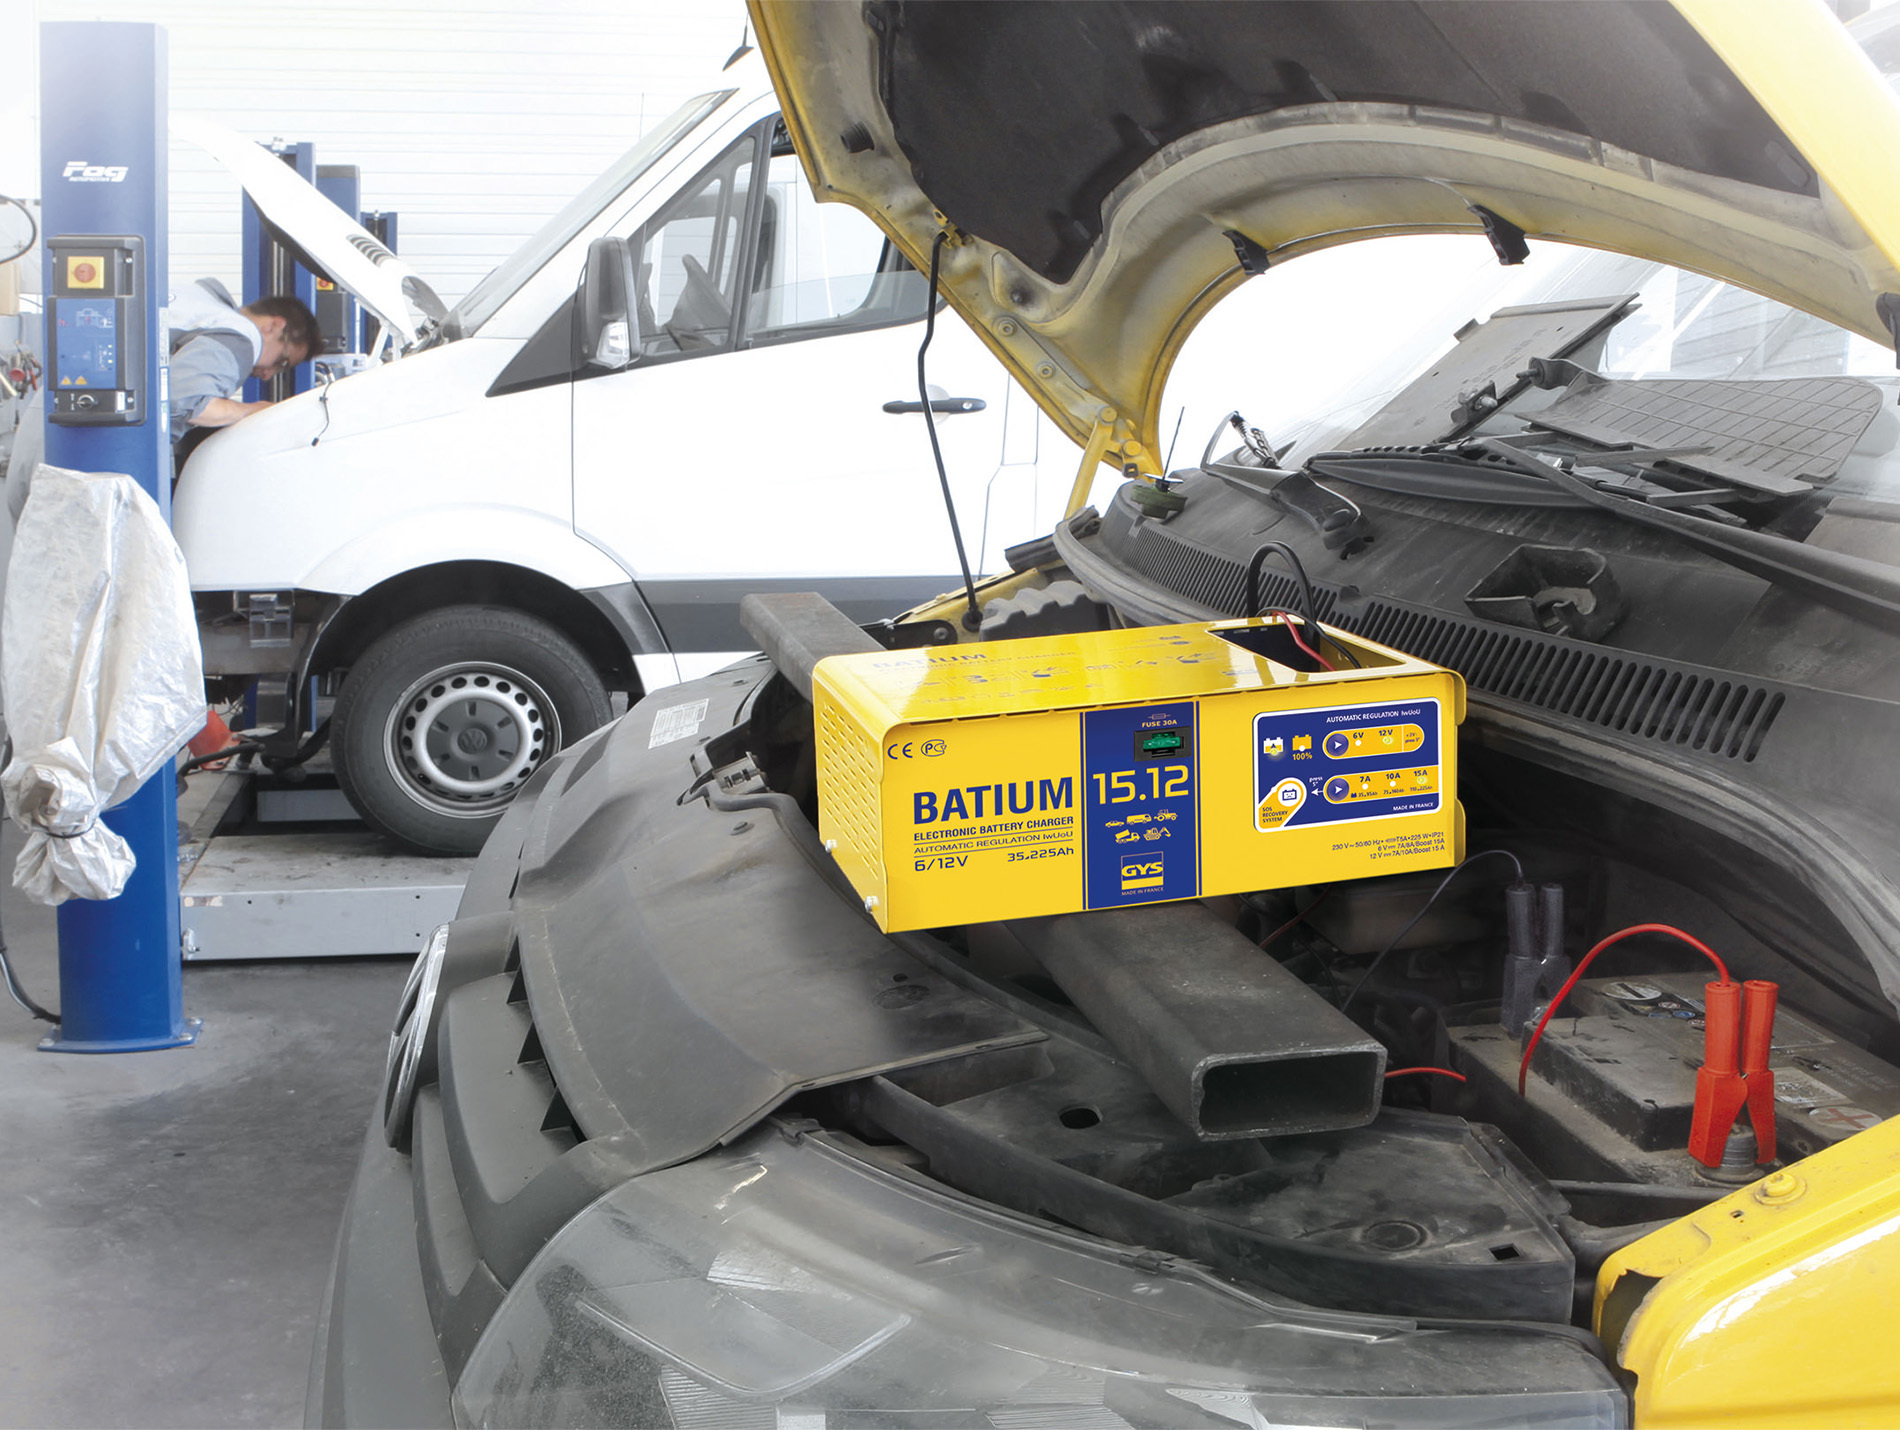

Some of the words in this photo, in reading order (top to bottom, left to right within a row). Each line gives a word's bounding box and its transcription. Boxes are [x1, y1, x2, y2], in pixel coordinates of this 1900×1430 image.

[1141, 720, 1161, 728] FUSE
[1326, 714, 1361, 724] AUTOMATIC
[1362, 710, 1399, 720] REGULATION
[887, 742, 913, 760] CE
[1292, 752, 1313, 761] 100%
[1092, 765, 1189, 805] 15.12
[913, 776, 1073, 825] BATIUM
[1262, 810, 1289, 818] RECOVERY
[1262, 816, 1283, 824] SYSTEM
[913, 826, 977, 842] ELECTRONIC
[979, 821, 1024, 835] BATTERY
[1026, 815, 1074, 830] CHARGER
[913, 841, 974, 855] AUTOMATIC
[976, 834, 1041, 848] REGULATION
[914, 855, 969, 872] 6/12V
[1121, 861, 1163, 877] GYS
[1144, 886, 1164, 894] FRANCE
